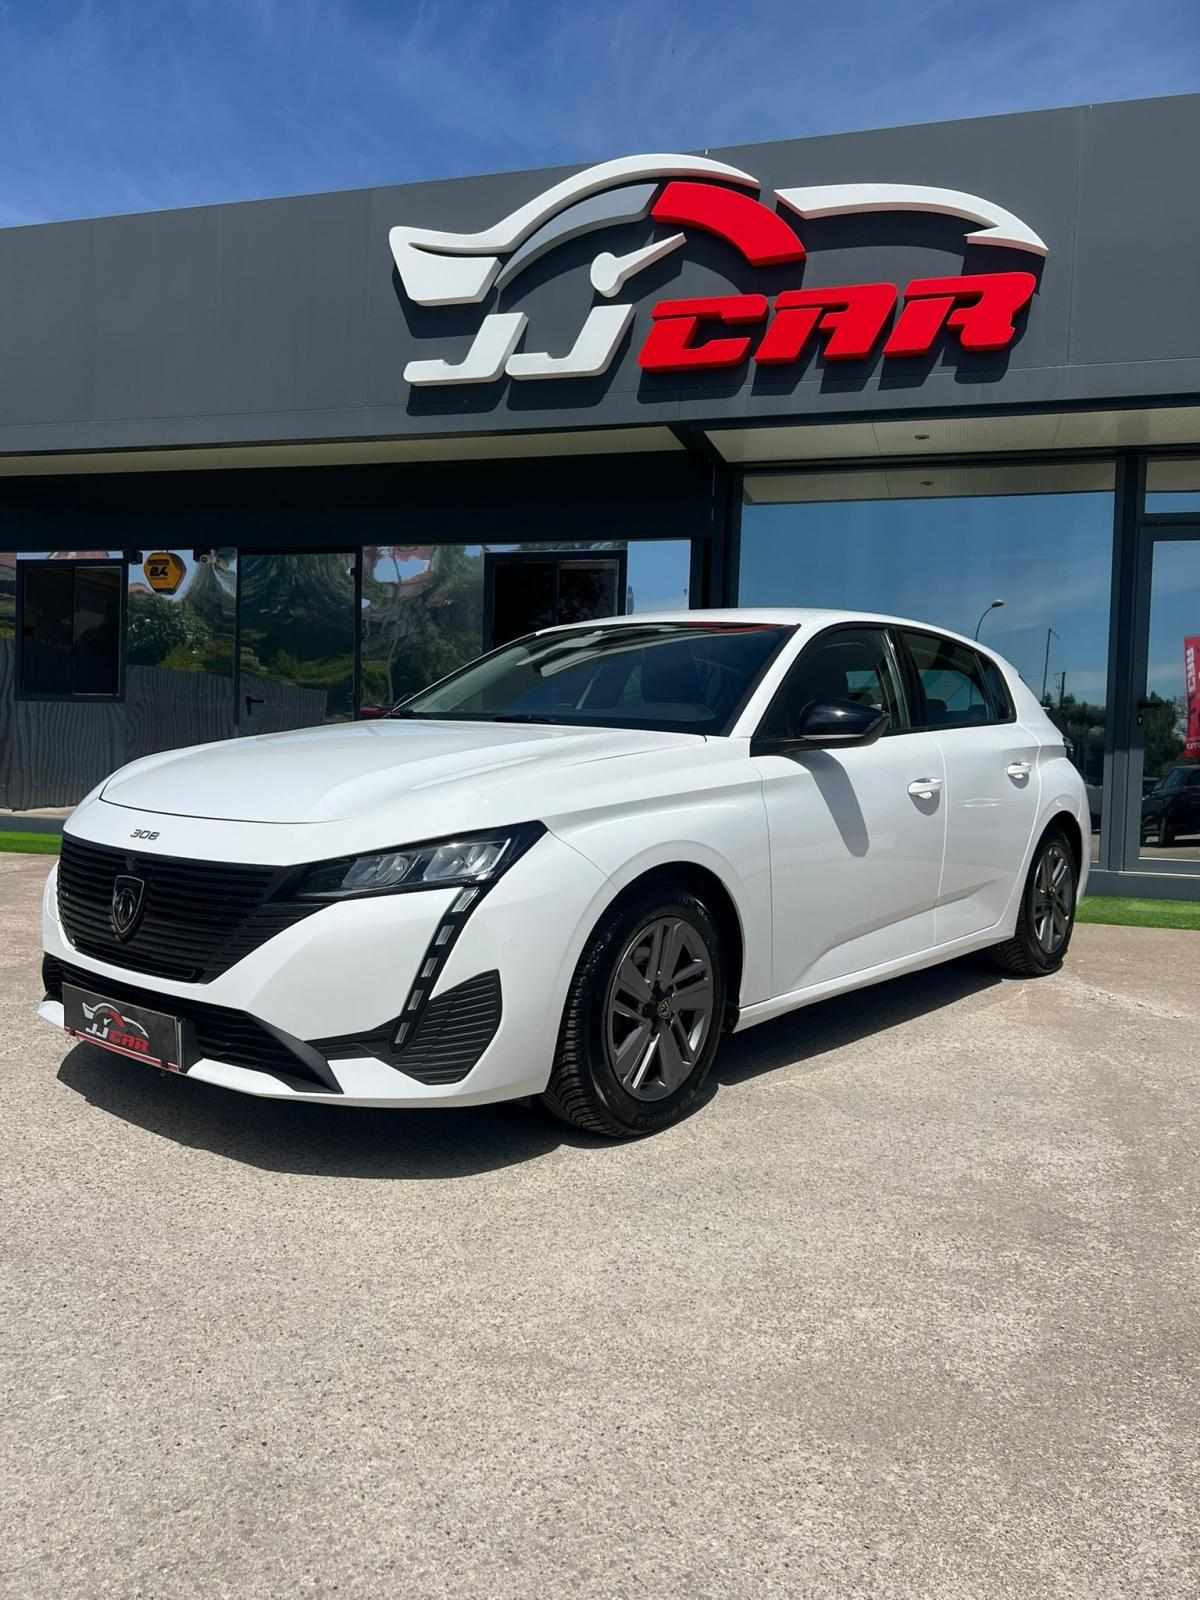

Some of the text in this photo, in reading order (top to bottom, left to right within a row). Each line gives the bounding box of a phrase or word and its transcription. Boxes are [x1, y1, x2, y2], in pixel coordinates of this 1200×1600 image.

[403, 272, 1037, 386] JJ CAR
[130, 829, 160, 840] 308
[109, 1030, 150, 1052] CAR
